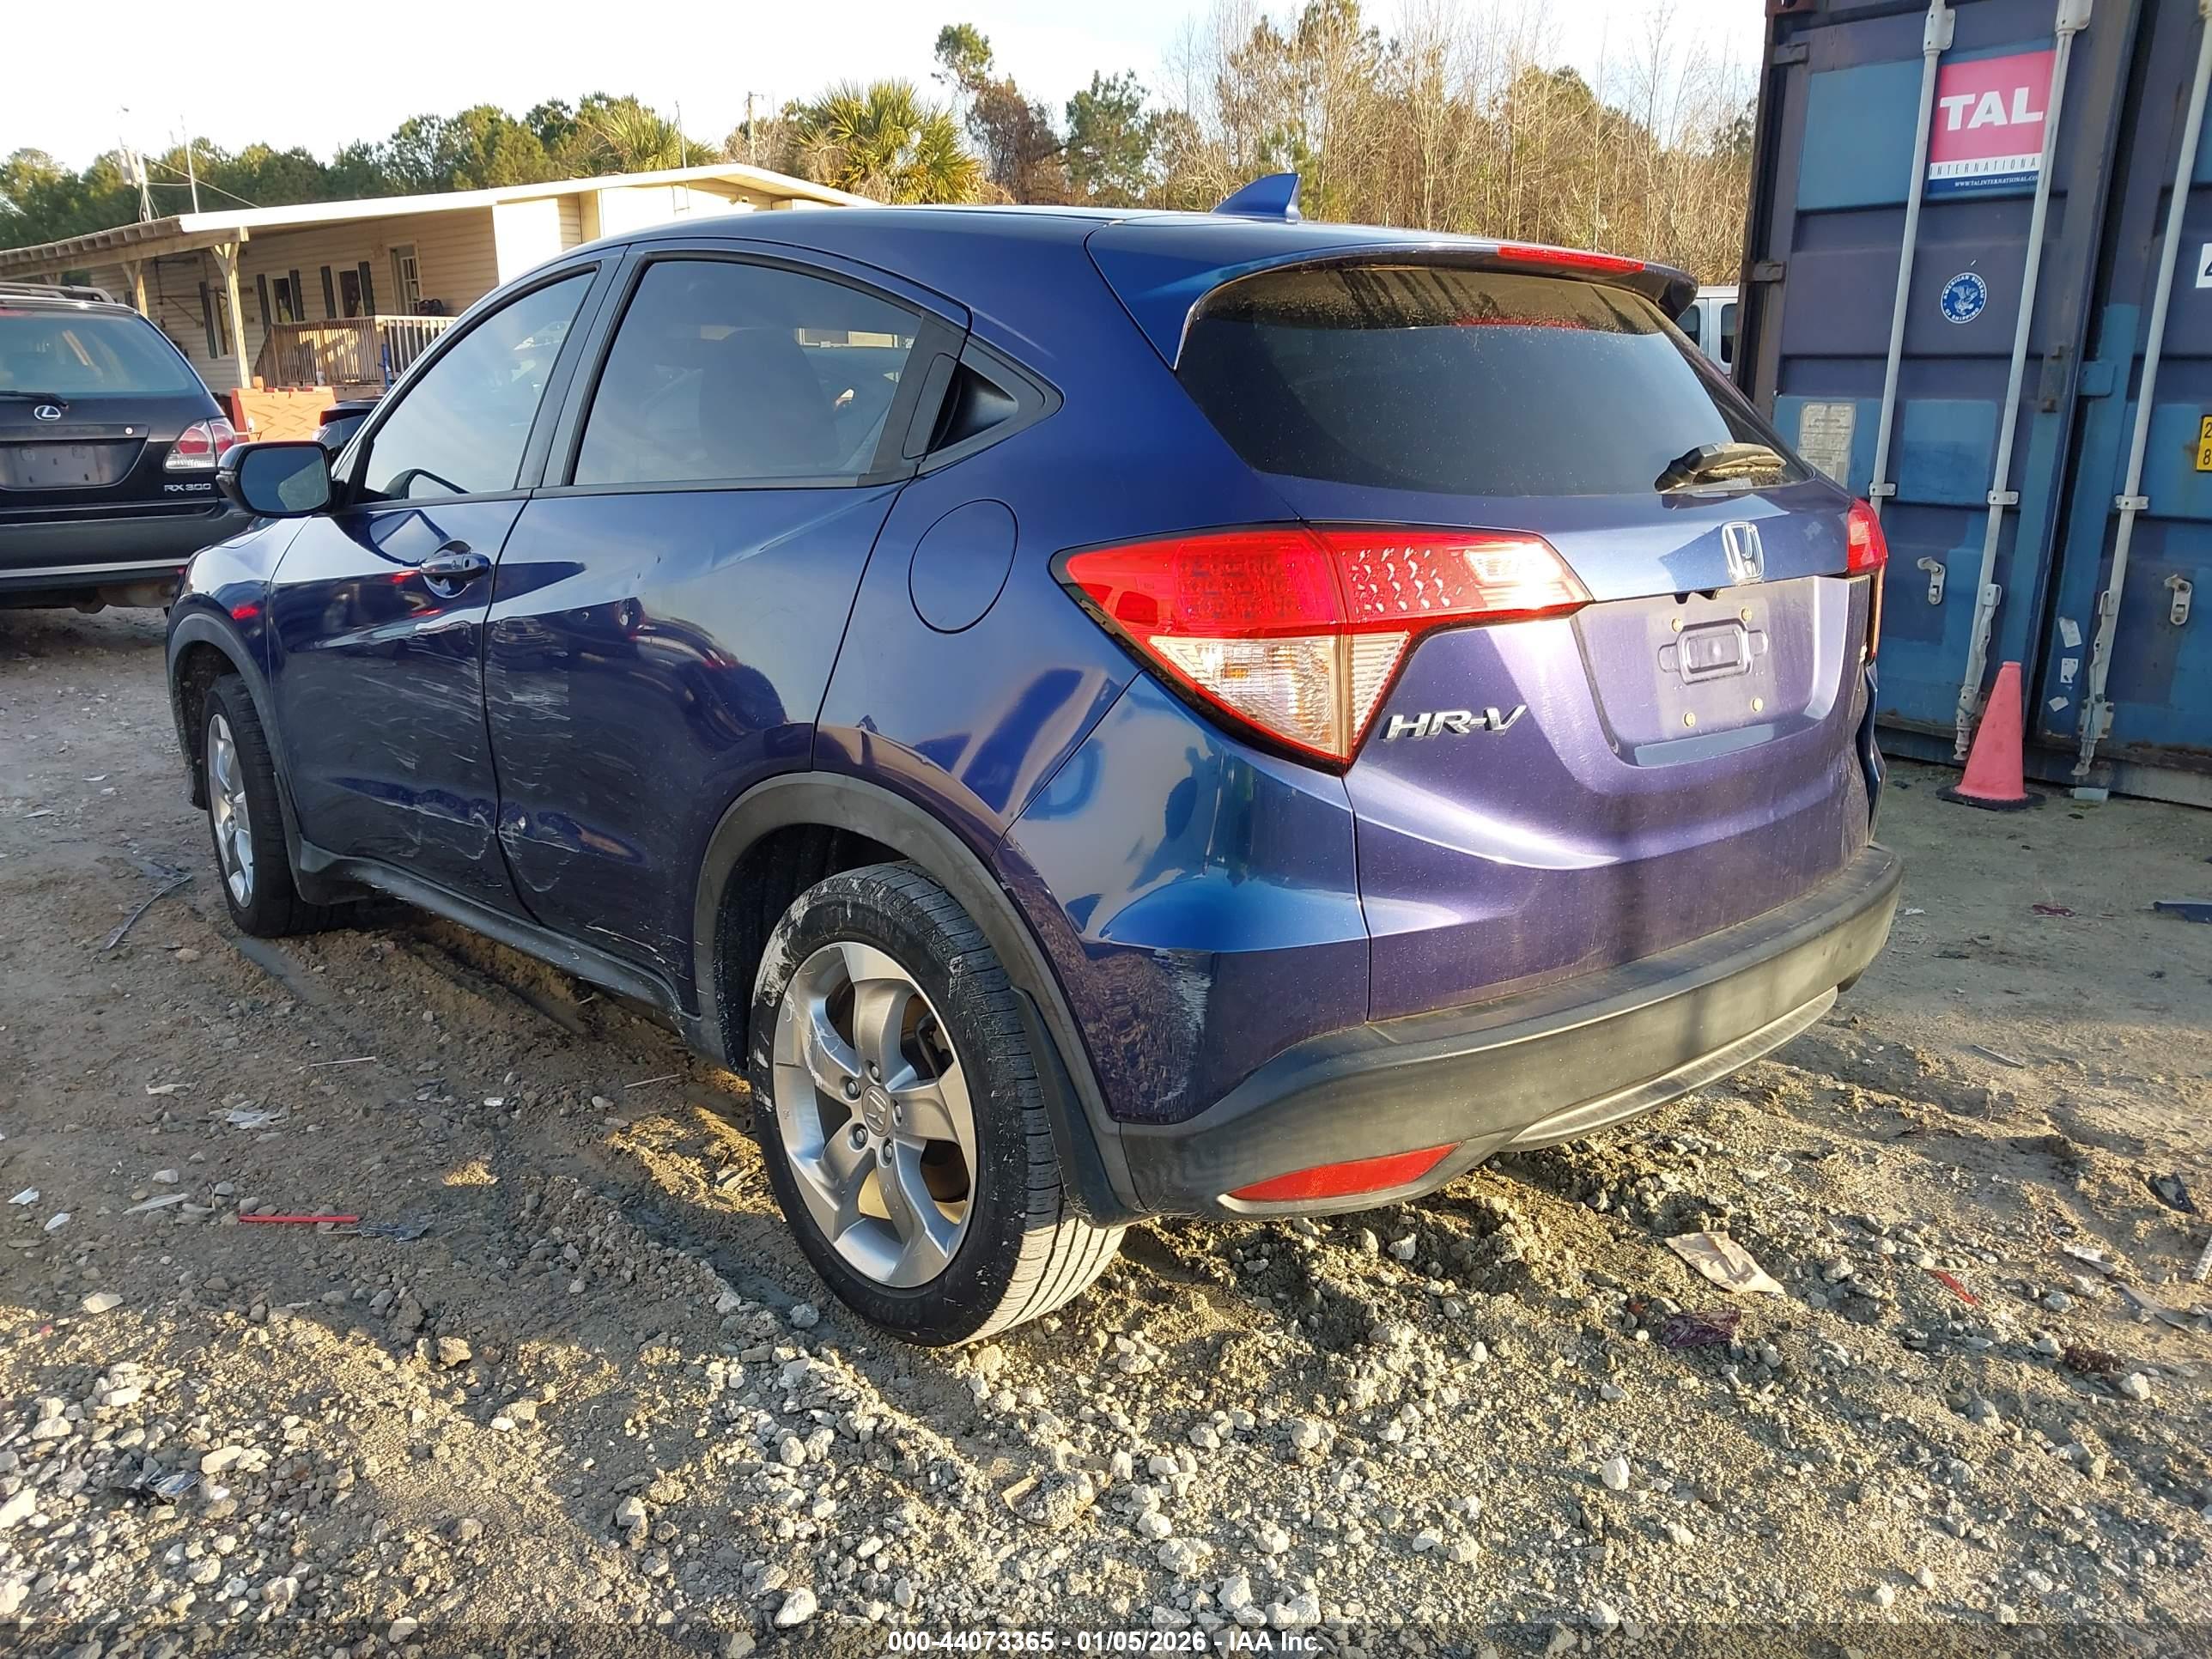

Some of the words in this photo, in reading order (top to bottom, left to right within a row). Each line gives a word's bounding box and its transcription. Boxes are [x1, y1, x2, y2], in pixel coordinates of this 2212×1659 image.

[1939, 87, 2044, 131] TAL
[1929, 157, 2037, 177] INTERNATIONA
[164, 483, 185, 492] RX
[185, 483, 212, 491] 300
[1379, 704, 1528, 740] HR-V
